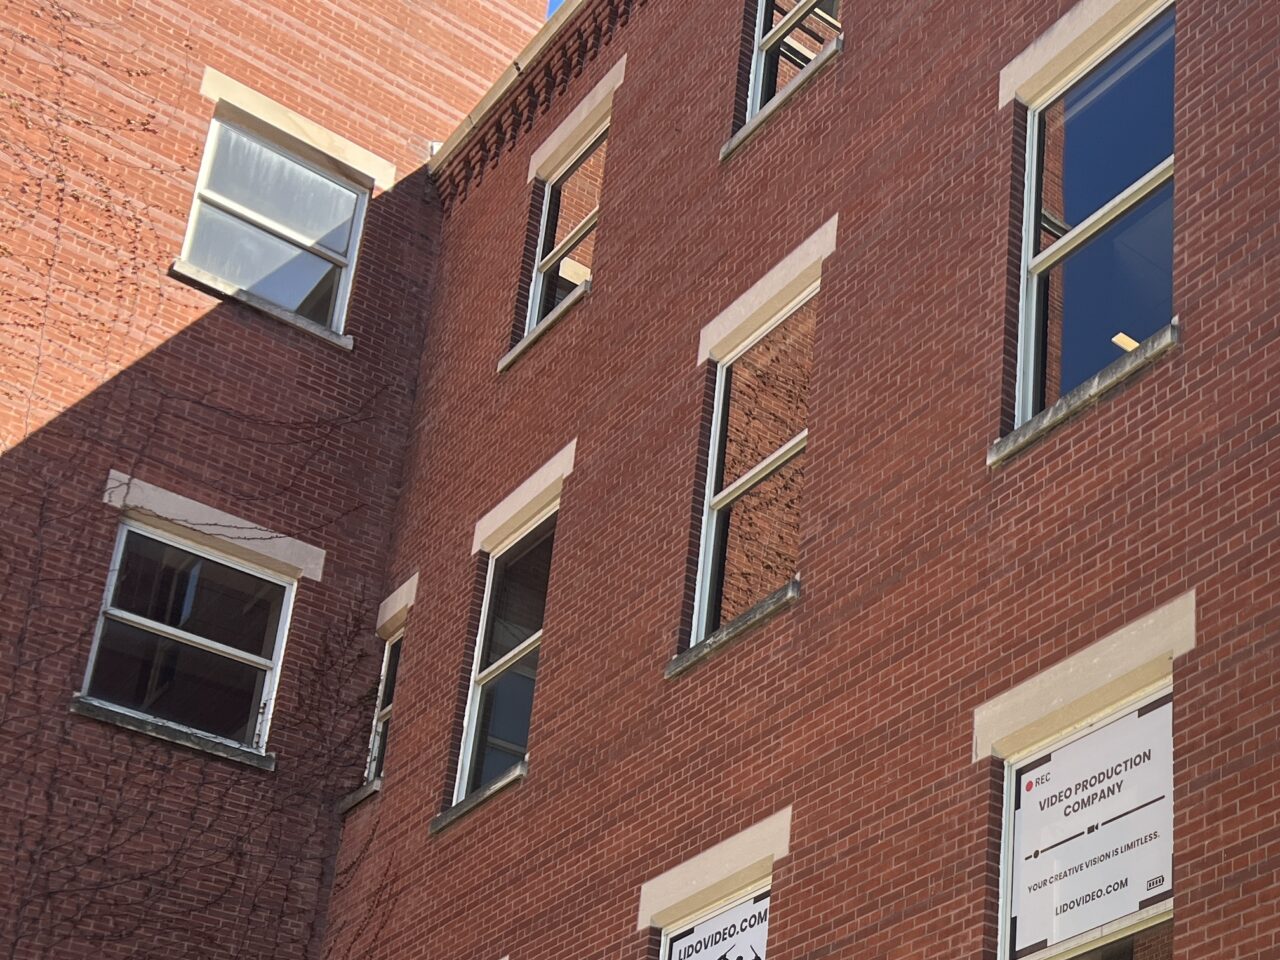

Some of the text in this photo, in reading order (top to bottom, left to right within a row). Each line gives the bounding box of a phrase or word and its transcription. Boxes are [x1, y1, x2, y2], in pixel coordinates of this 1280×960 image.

[1035, 772, 1051, 787] REC
[1039, 749, 1151, 811] VIDEO PRODUCTION
[1063, 780, 1123, 817] COMPANY
[1027, 879, 1048, 894] YOUR
[1048, 863, 1084, 884] CREATIVE
[1084, 851, 1111, 869] VISION
[1111, 847, 1119, 858] IS
[1055, 877, 1129, 916] LIDOVIDEO.COM
